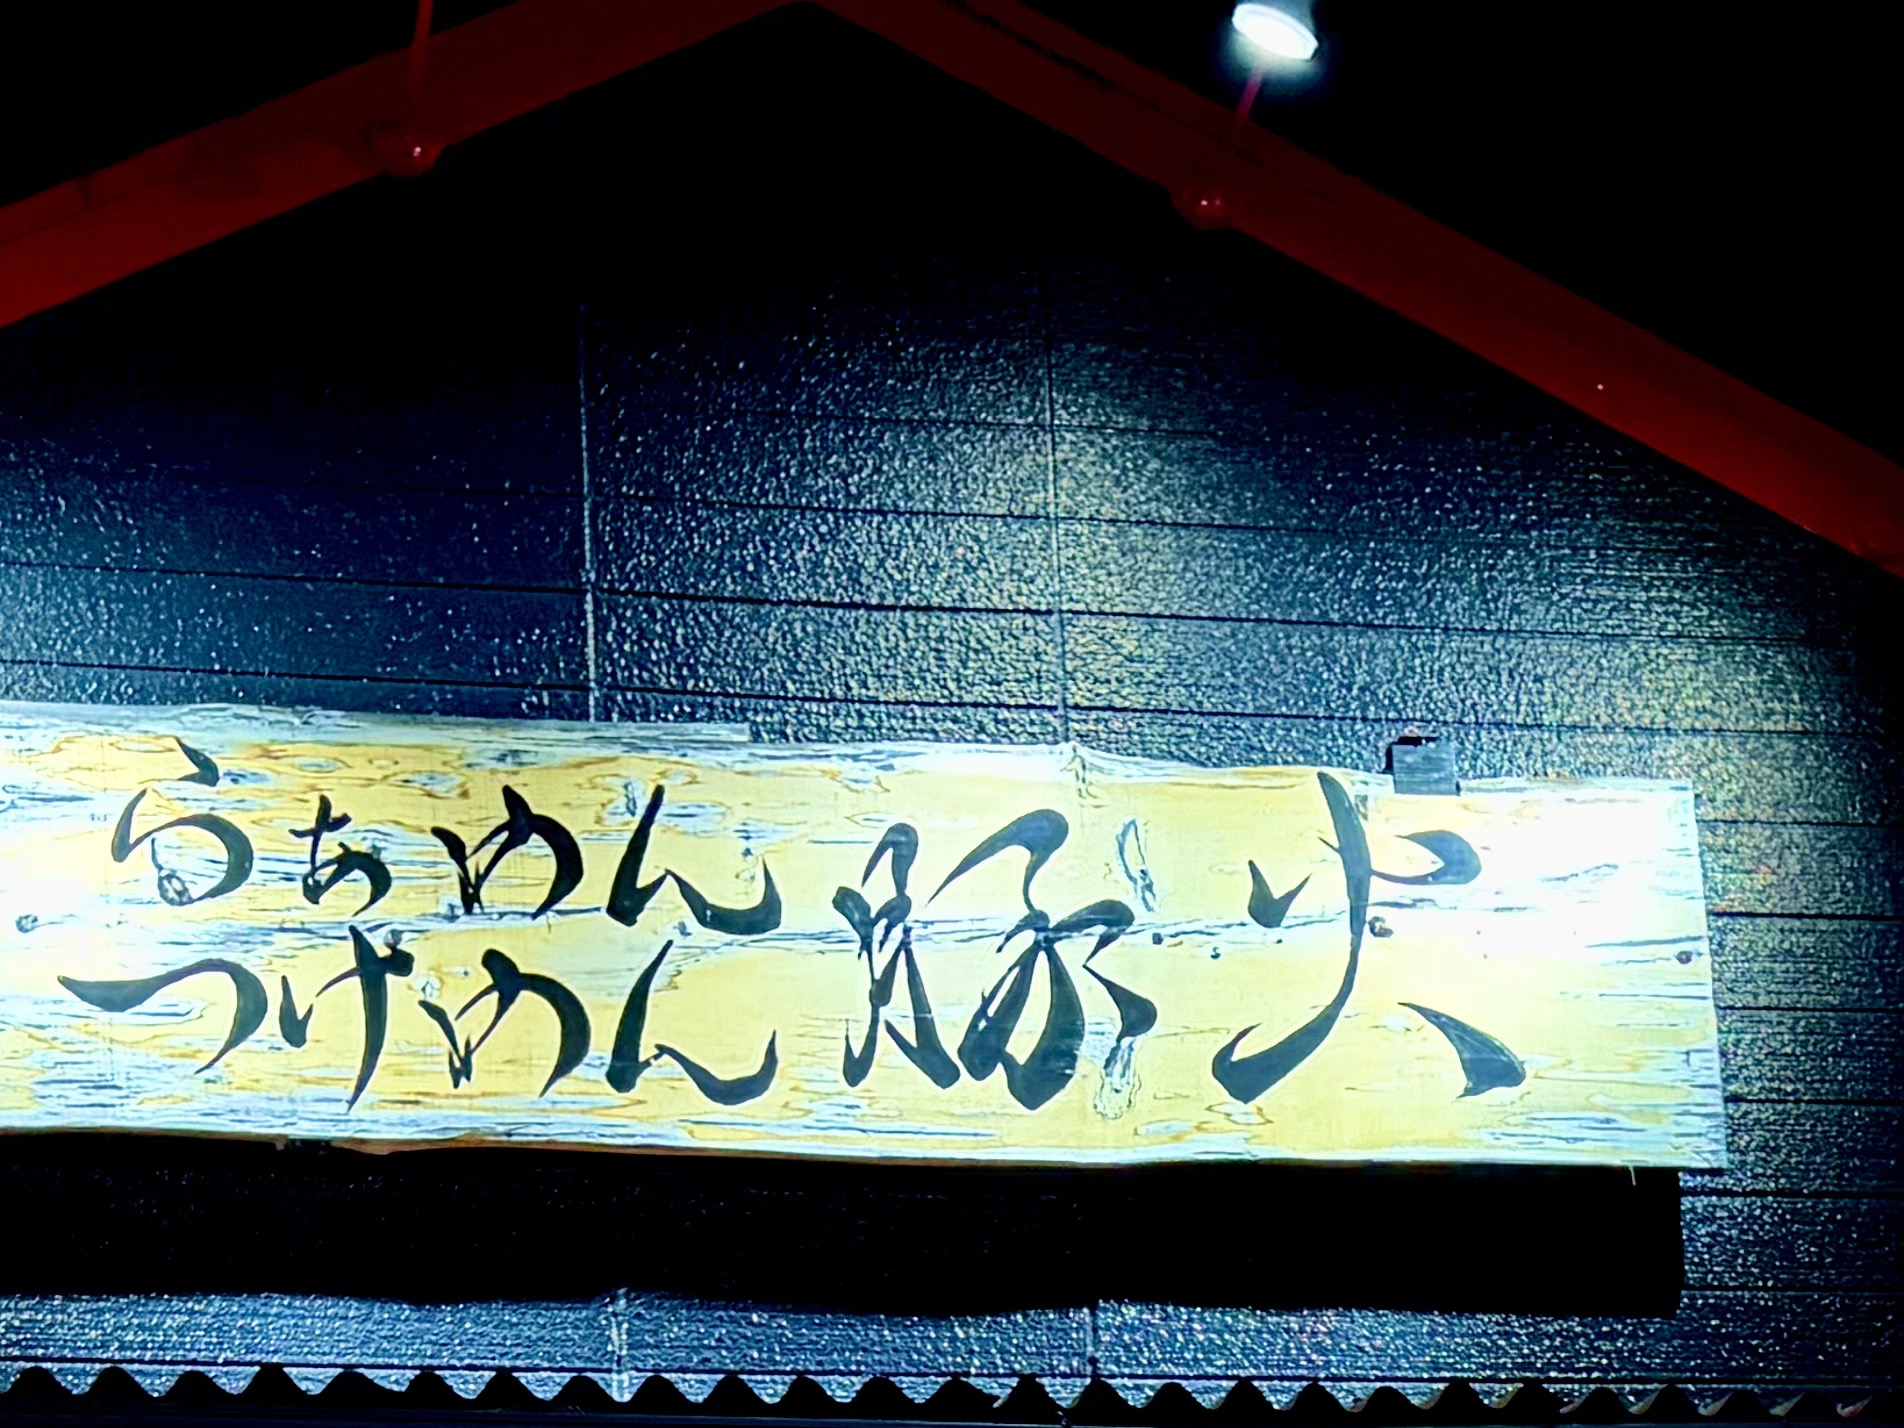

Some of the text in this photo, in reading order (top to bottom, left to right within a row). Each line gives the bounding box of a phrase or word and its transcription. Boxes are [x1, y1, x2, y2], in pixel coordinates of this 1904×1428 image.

[112, 737, 780, 936] らぁめん
[56, 923, 779, 1110] つけめん
